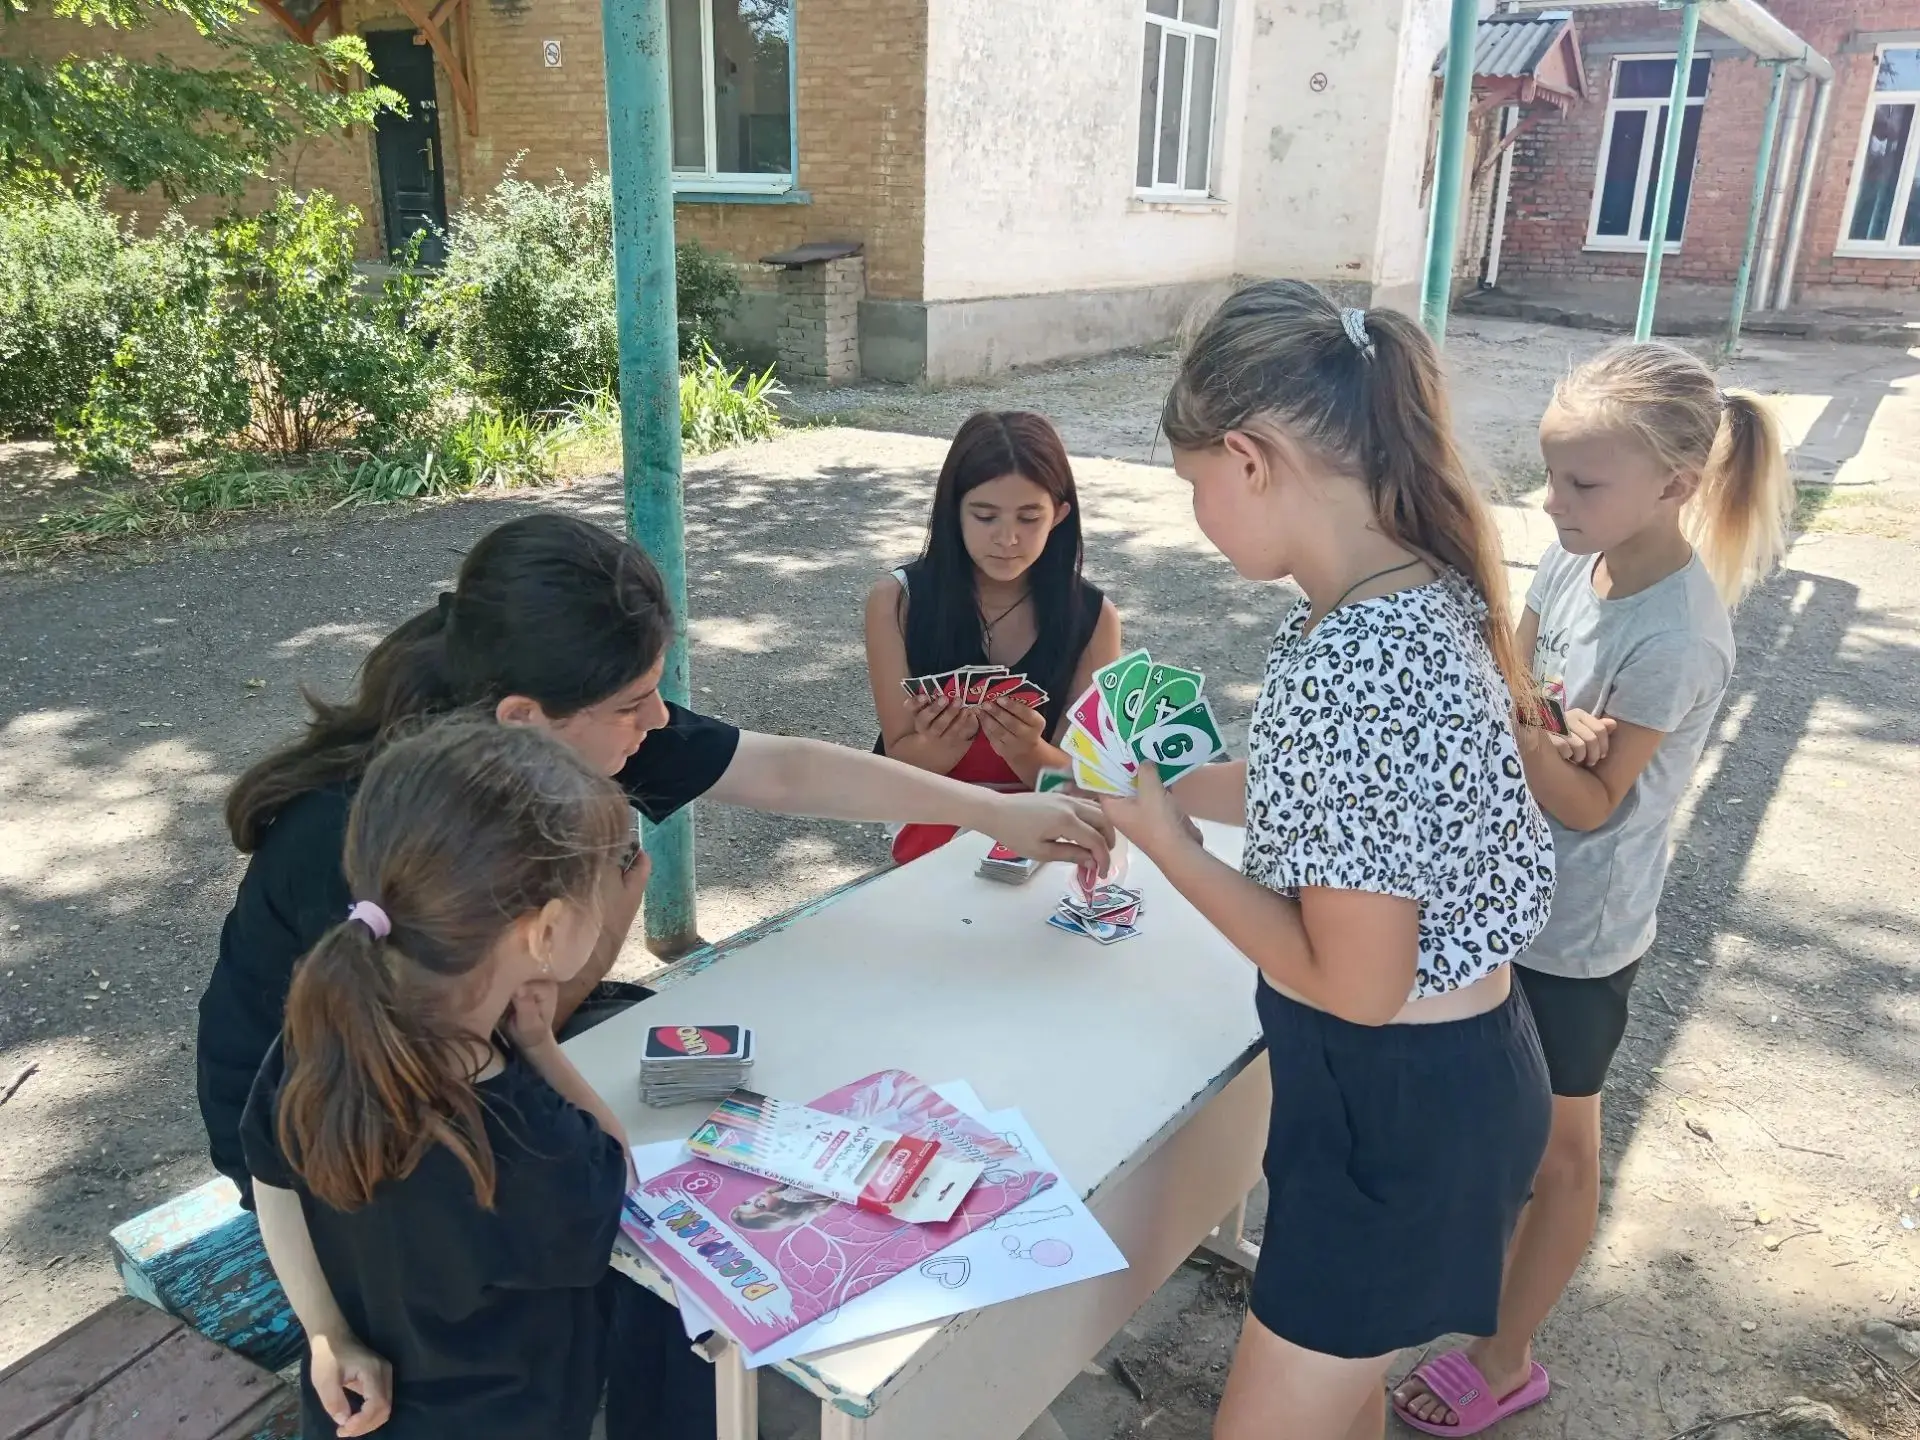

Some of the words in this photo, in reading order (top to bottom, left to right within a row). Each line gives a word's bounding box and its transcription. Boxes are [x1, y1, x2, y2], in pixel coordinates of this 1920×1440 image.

[1152, 669, 1164, 684] 4
[1154, 696, 1180, 724] 4
[1156, 732, 1194, 760] 6
[676, 1026, 709, 1056] UNO
[815, 1130, 833, 1143] 12
[686, 1177, 709, 1191] 8
[657, 1199, 779, 1301] РАСКРАСКА
